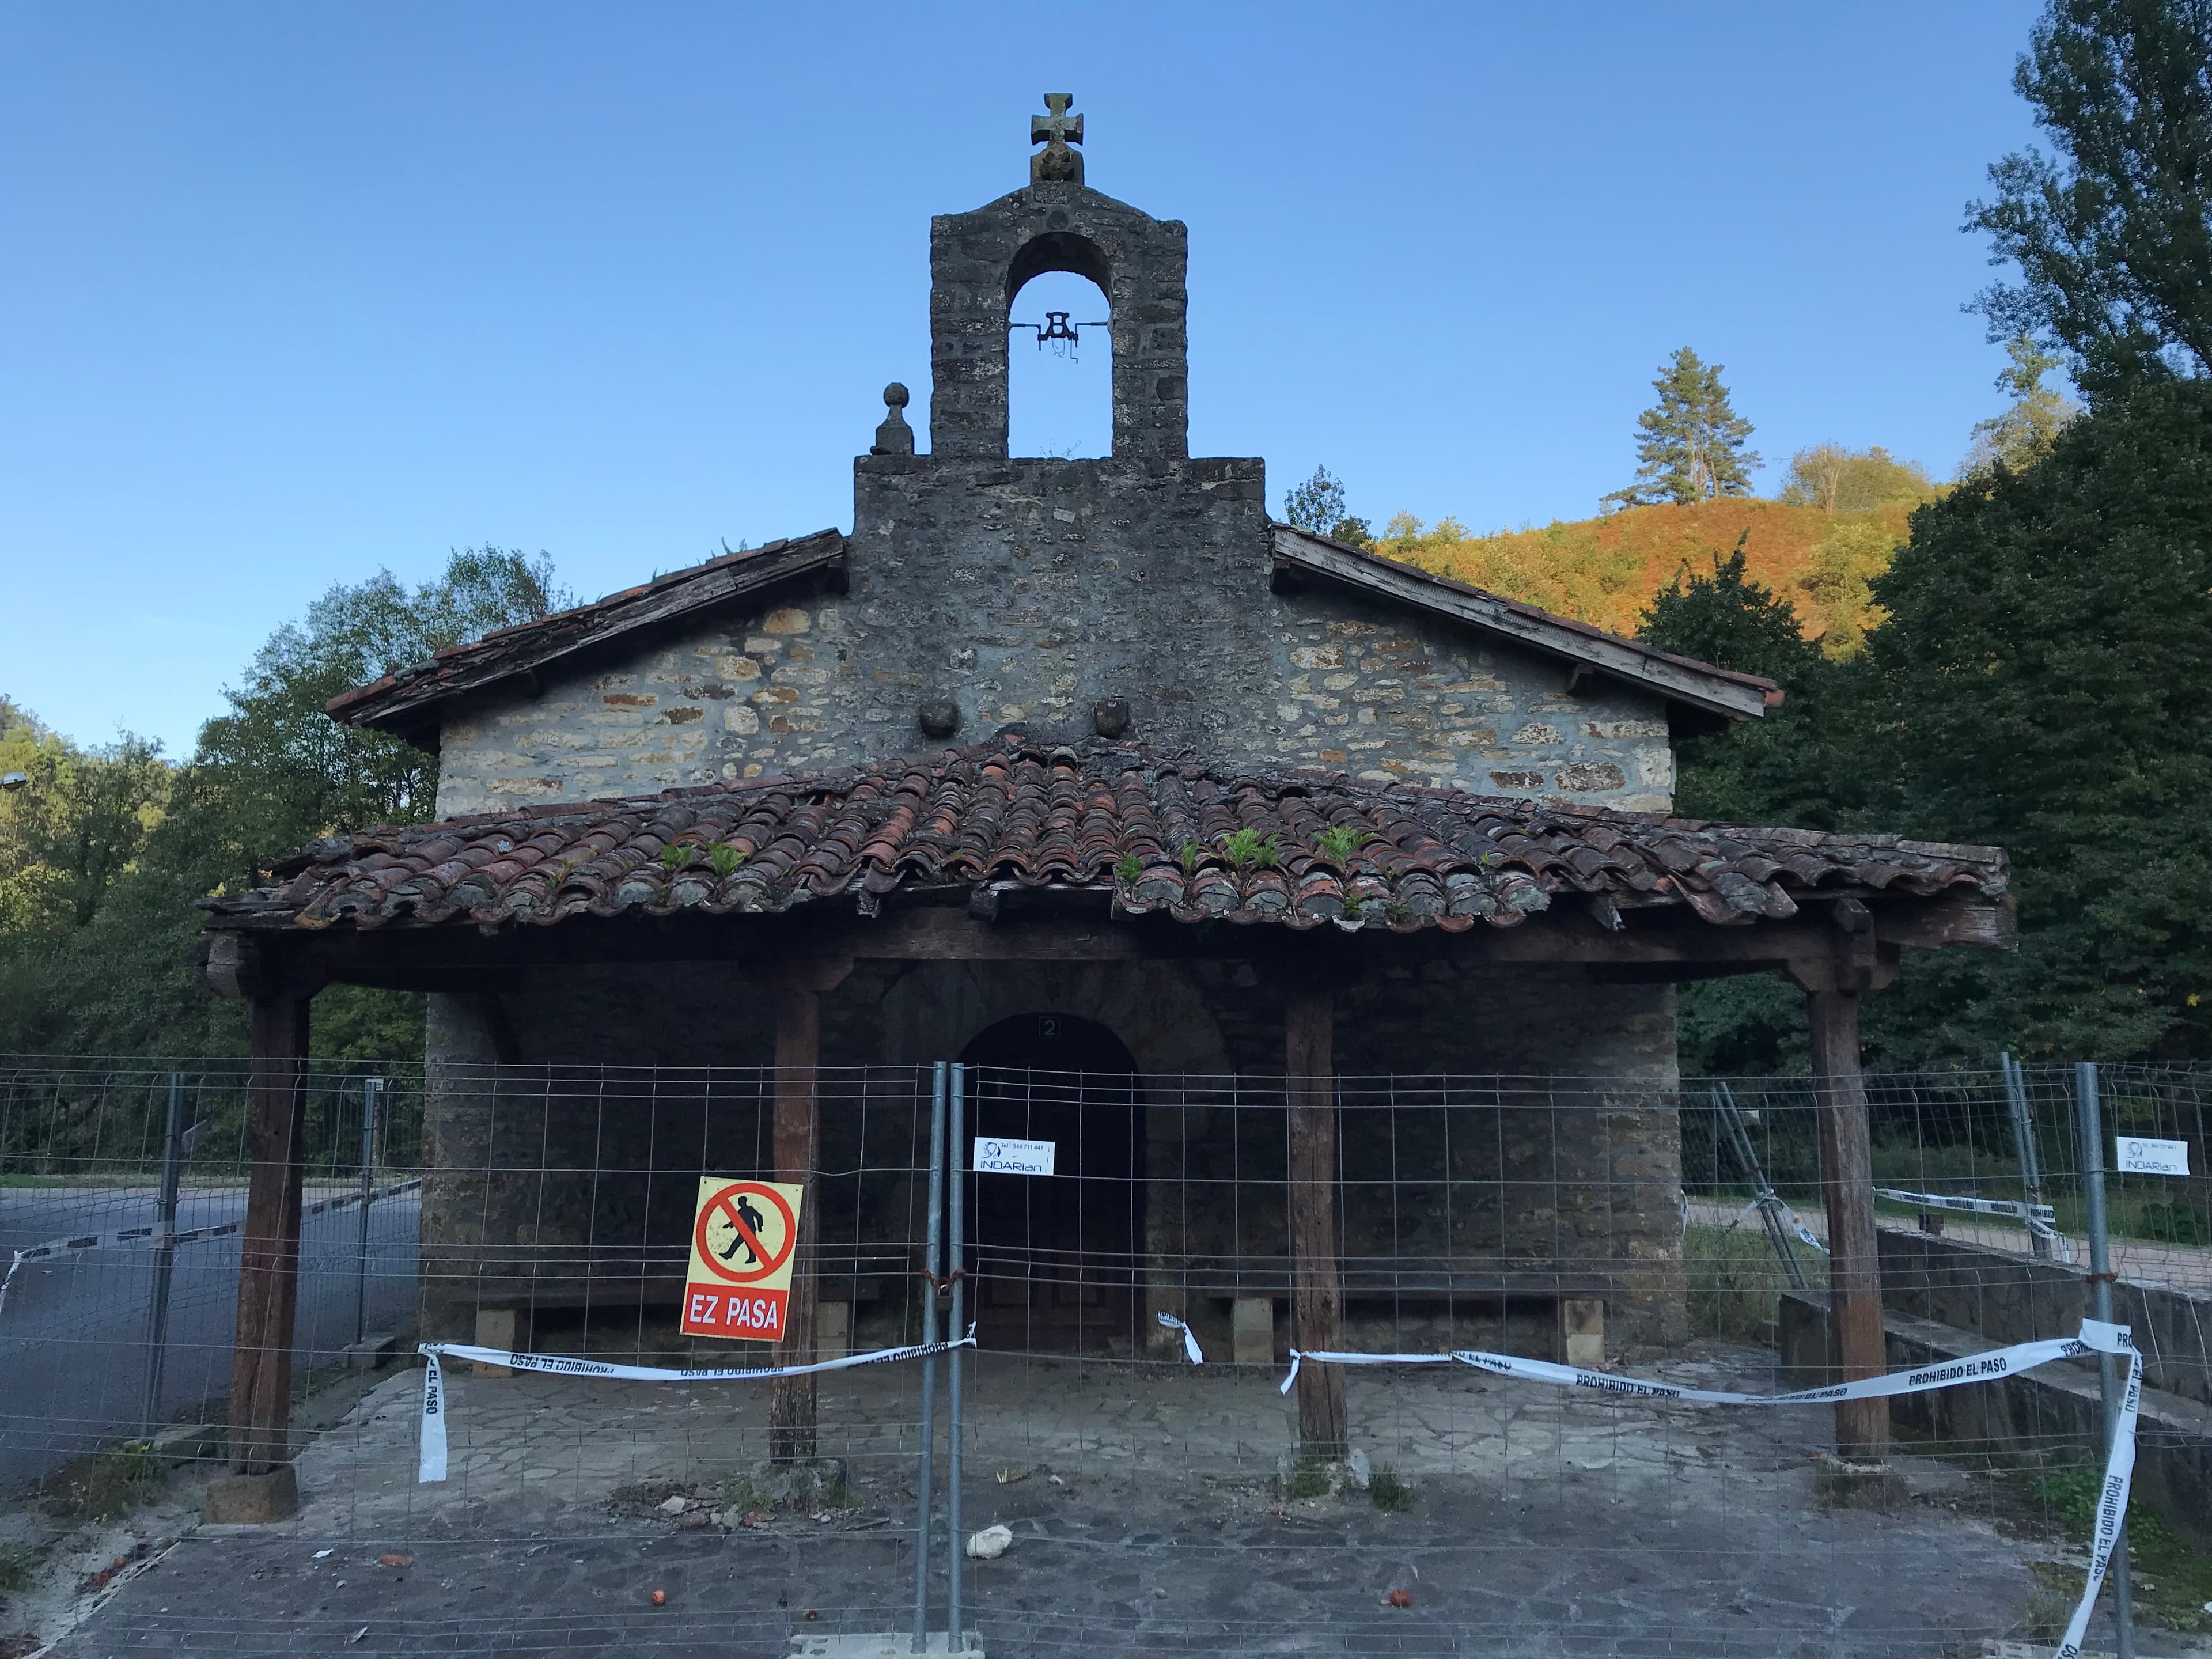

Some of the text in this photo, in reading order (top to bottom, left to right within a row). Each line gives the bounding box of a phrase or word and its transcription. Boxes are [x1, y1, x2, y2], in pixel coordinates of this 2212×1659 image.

[1044, 1020, 1055, 1035] 2
[690, 1293, 778, 1330] EZ PASA
[510, 1353, 539, 1368] PASO
[541, 1358, 555, 1370] EL
[428, 1370, 438, 1383] EL
[1908, 1357, 2007, 1387] PROHIBIDO EL PASO
[1575, 1373, 1680, 1398] PROHIBIDO EL PASO
[426, 1386, 438, 1415] PASO
[2100, 1475, 2124, 1537] PROHIBIDO
[2097, 1537, 2111, 1552] EL
